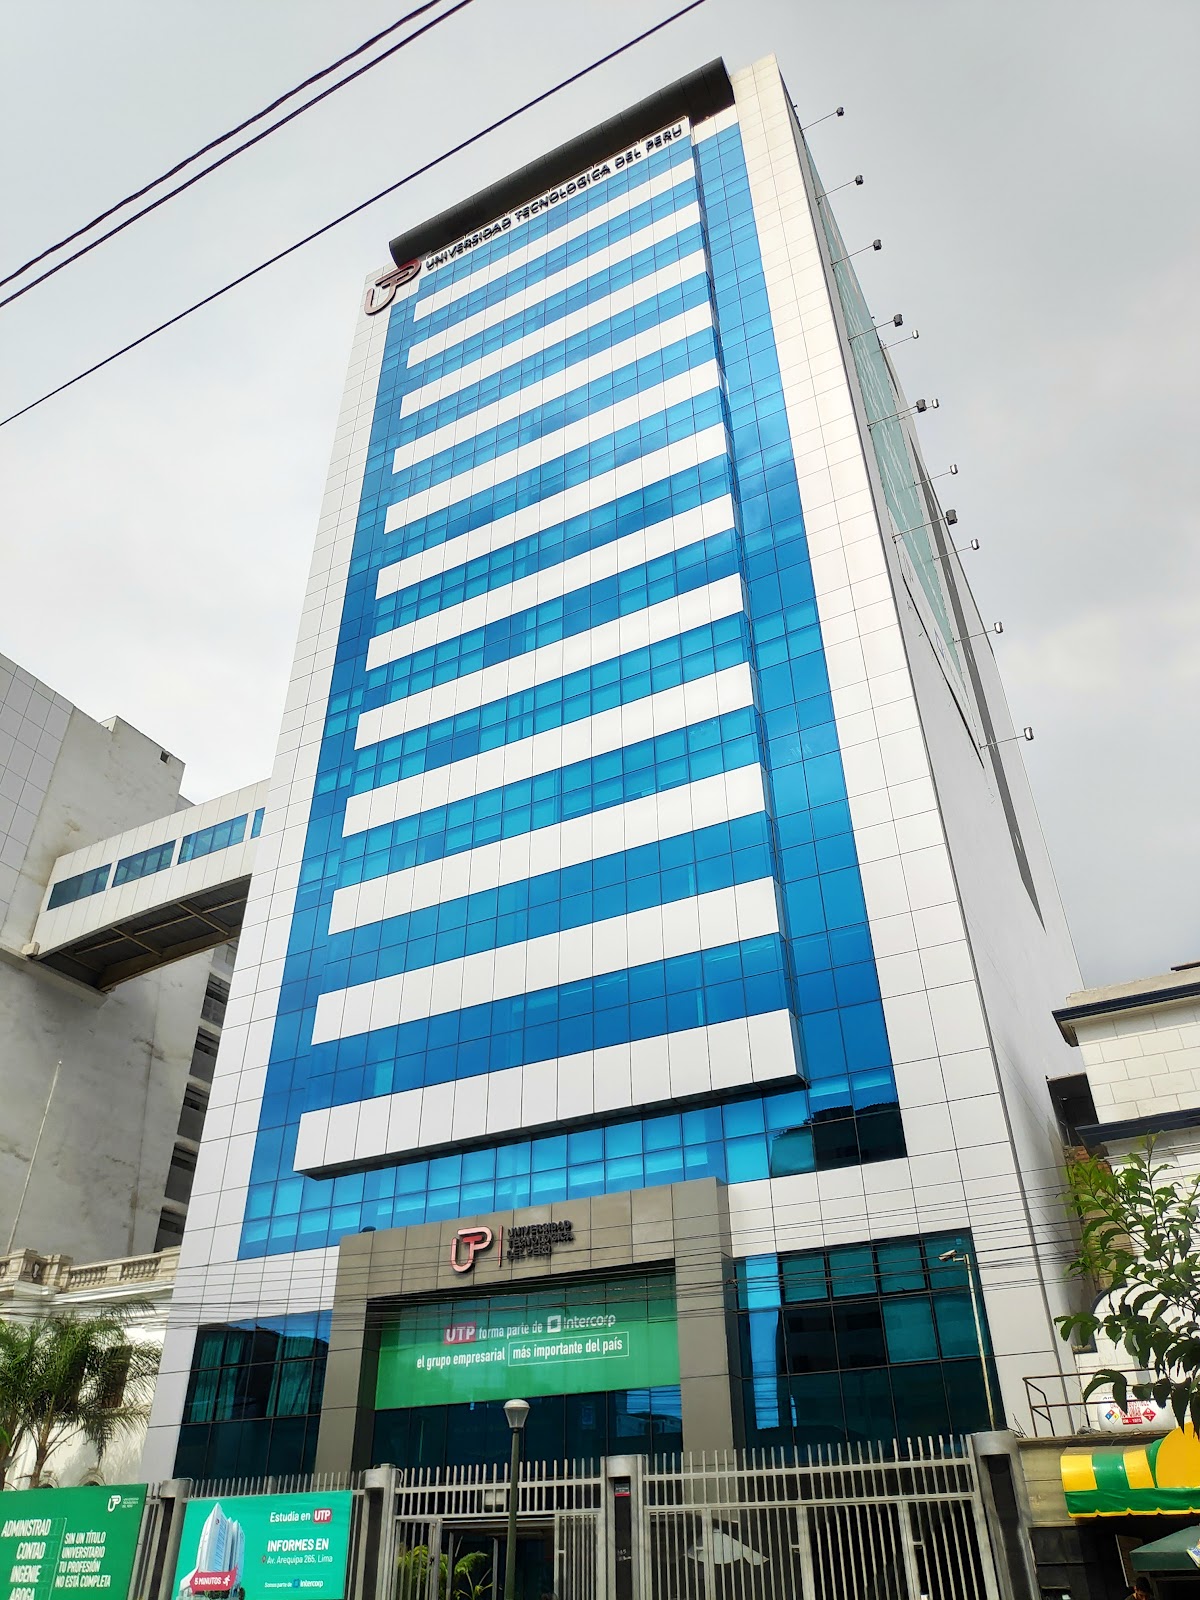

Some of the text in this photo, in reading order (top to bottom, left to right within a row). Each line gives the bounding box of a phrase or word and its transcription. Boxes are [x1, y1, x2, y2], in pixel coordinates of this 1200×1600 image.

[426, 217, 511, 271] UNIVERSIDAD
[514, 164, 611, 221] TECNOLOGICA
[615, 148, 641, 169] DEL
[364, 258, 421, 316] UTP
[508, 1220, 572, 1238] UNIVERSIDAD
[451, 1226, 492, 1273] UTP
[445, 1321, 543, 1342] UTP forma parte de
[416, 1336, 623, 1370] el grupo empresarial más importante del país
[108, 1495, 121, 1512] UTP
[270, 1509, 331, 1522] Estudia en UTP
[1, 1518, 52, 1537] ADMINISTRAD
[64, 1529, 106, 1544] SIN UN TÍTULO
[267, 1538, 330, 1552] INFORMES EN
[16, 1541, 46, 1560] CONTAD
[61, 1546, 105, 1559] UNIVERSITARIO
[59, 1558, 101, 1573] TU PROFESIÓN
[267, 1556, 276, 1564] Av.
[277, 1556, 303, 1565] Arequipa
[318, 1554, 333, 1562] Lima
[10, 1564, 42, 1583] INGENIE
[55, 1573, 111, 1588] NO ESTÁ COMPLETA
[194, 1576, 221, 1585] 5 MINUTOS
